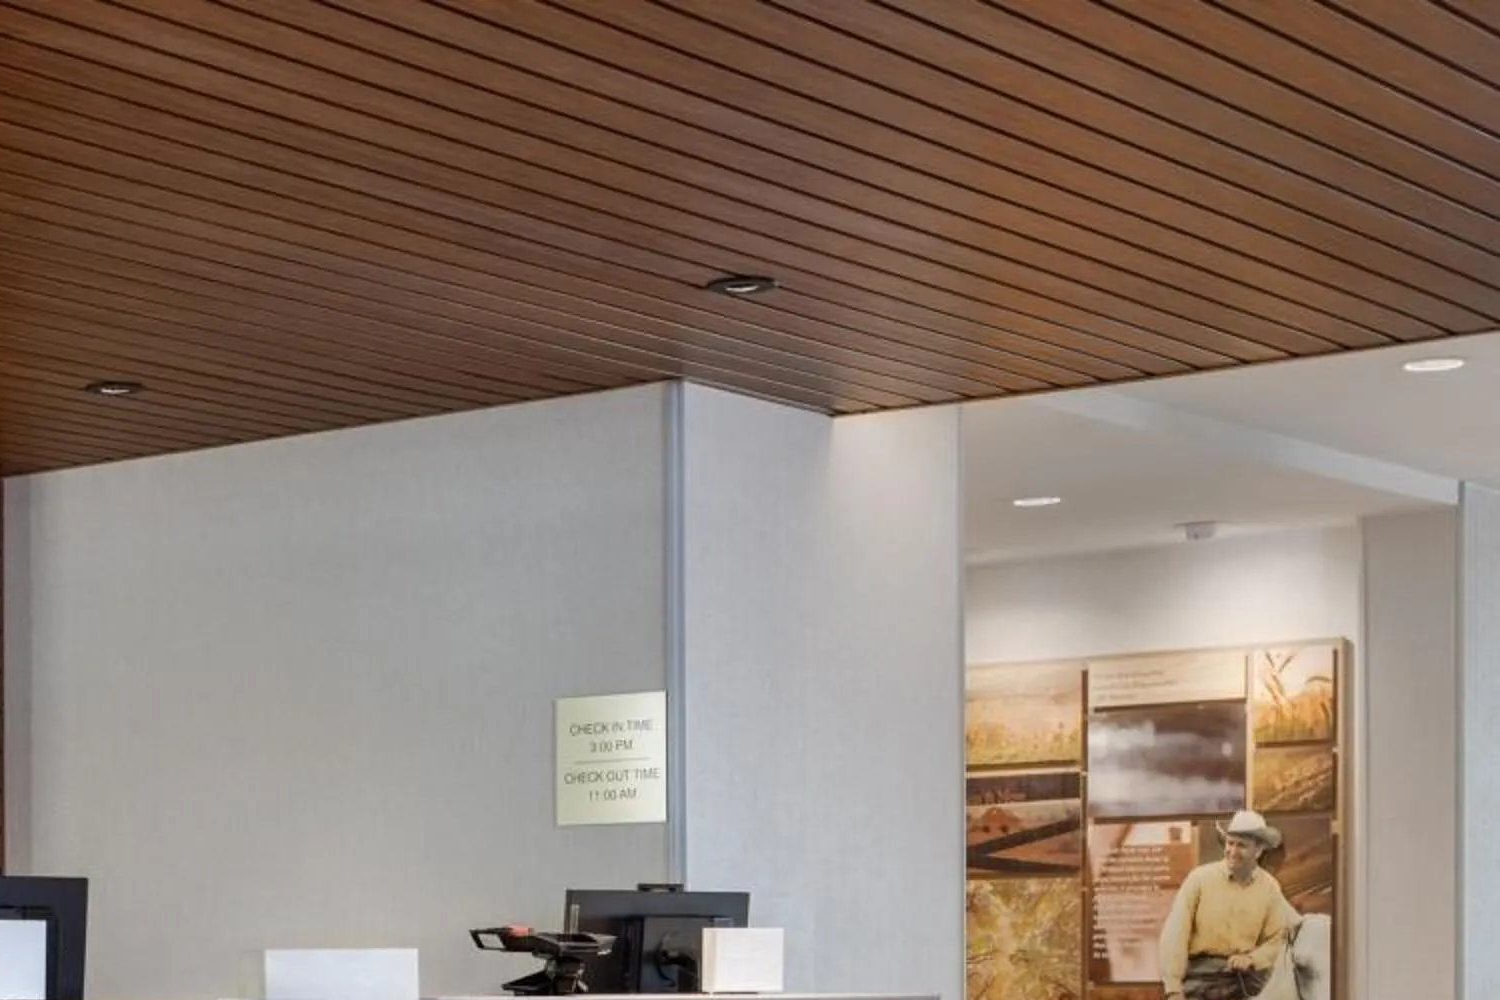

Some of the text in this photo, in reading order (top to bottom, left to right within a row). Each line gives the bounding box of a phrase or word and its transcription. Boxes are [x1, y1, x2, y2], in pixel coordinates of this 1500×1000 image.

[569, 722, 609, 736] CHECK
[590, 739, 633, 753] 300 PM
[564, 767, 661, 784] CHECK OUT TIME
[589, 788, 637, 802] 1100 AM
